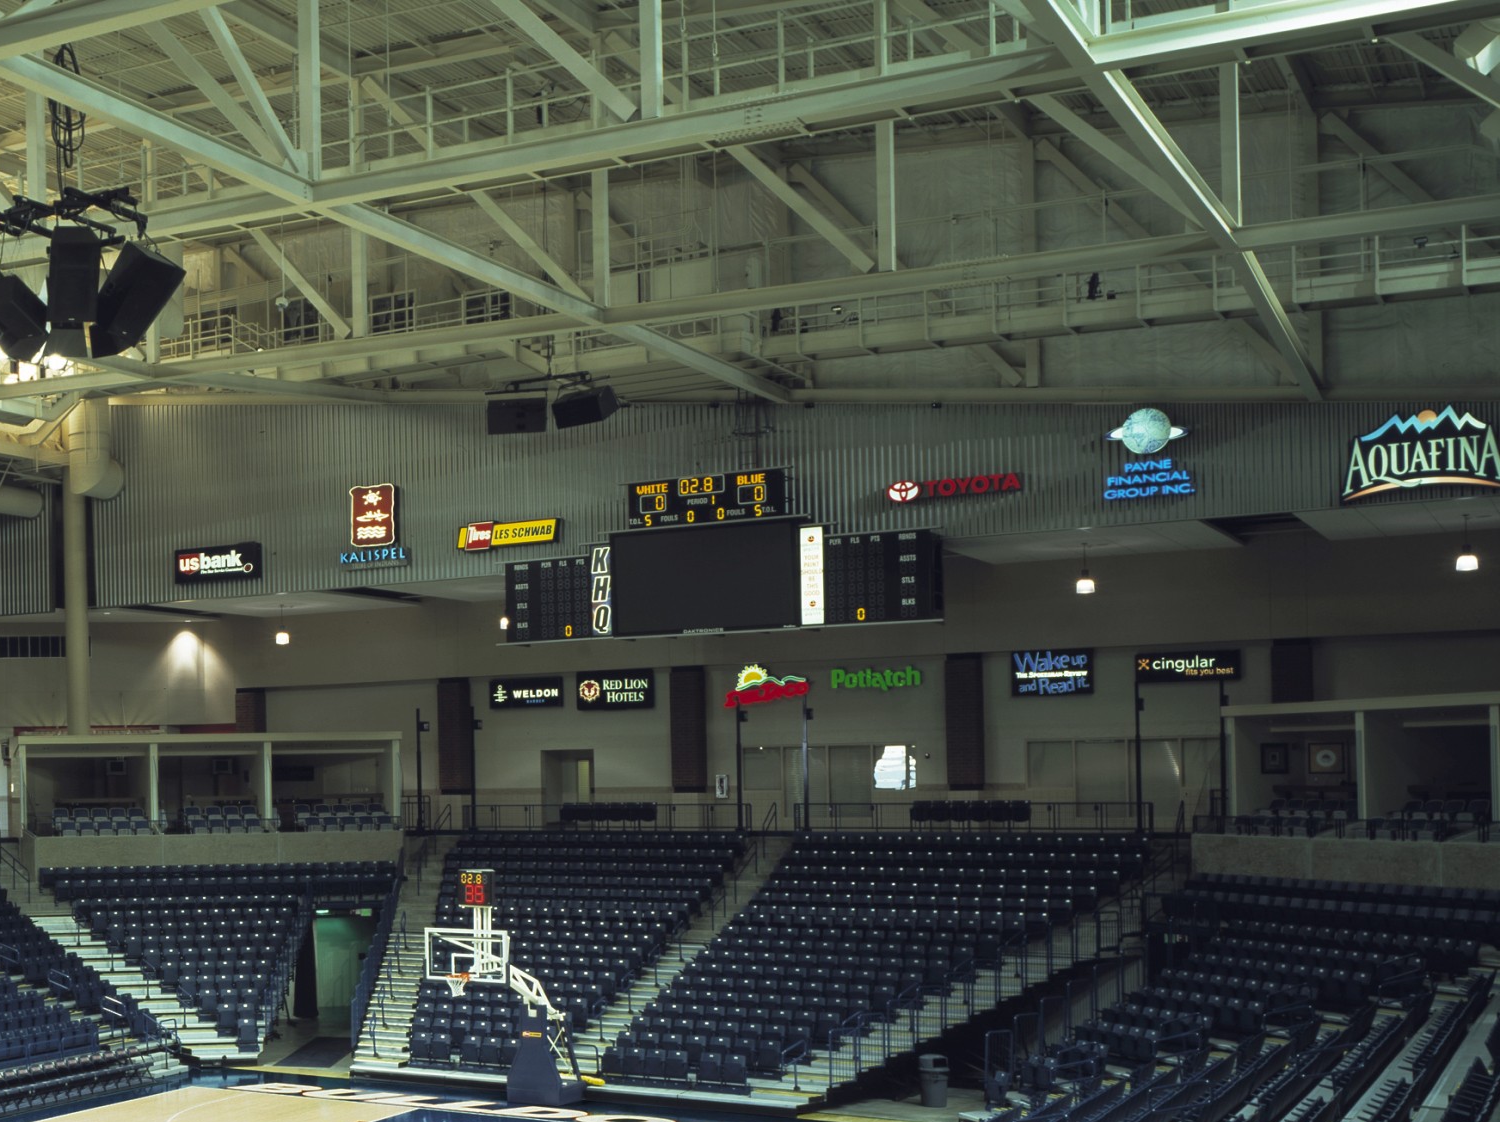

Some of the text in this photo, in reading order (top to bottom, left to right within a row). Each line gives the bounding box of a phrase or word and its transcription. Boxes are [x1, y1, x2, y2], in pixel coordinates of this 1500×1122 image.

[1124, 459, 1172, 472] PAYNE
[1342, 424, 1500, 497] AQUAFINA
[736, 473, 766, 486] BLUE
[924, 472, 1021, 497] TOYOTA
[1107, 470, 1190, 486] FINANCIAL
[636, 483, 668, 495] WHITE
[1104, 484, 1196, 500] GROUP INC.
[660, 514, 678, 523] FOULS
[726, 508, 746, 516] FOULS
[494, 529, 510, 540] LES
[512, 524, 553, 538] SCHWAB
[340, 547, 406, 563] KALISPEL
[1014, 651, 1088, 672] Wake up
[1152, 655, 1216, 672] cingular
[831, 666, 921, 691] Potlatch
[1185, 668, 1198, 676] fits
[1216, 667, 1234, 675] best
[602, 678, 648, 690] RED LION
[1019, 678, 1037, 692] and
[1038, 678, 1075, 695] Read
[513, 688, 559, 699] WELDON
[606, 691, 645, 703] HOTELS
